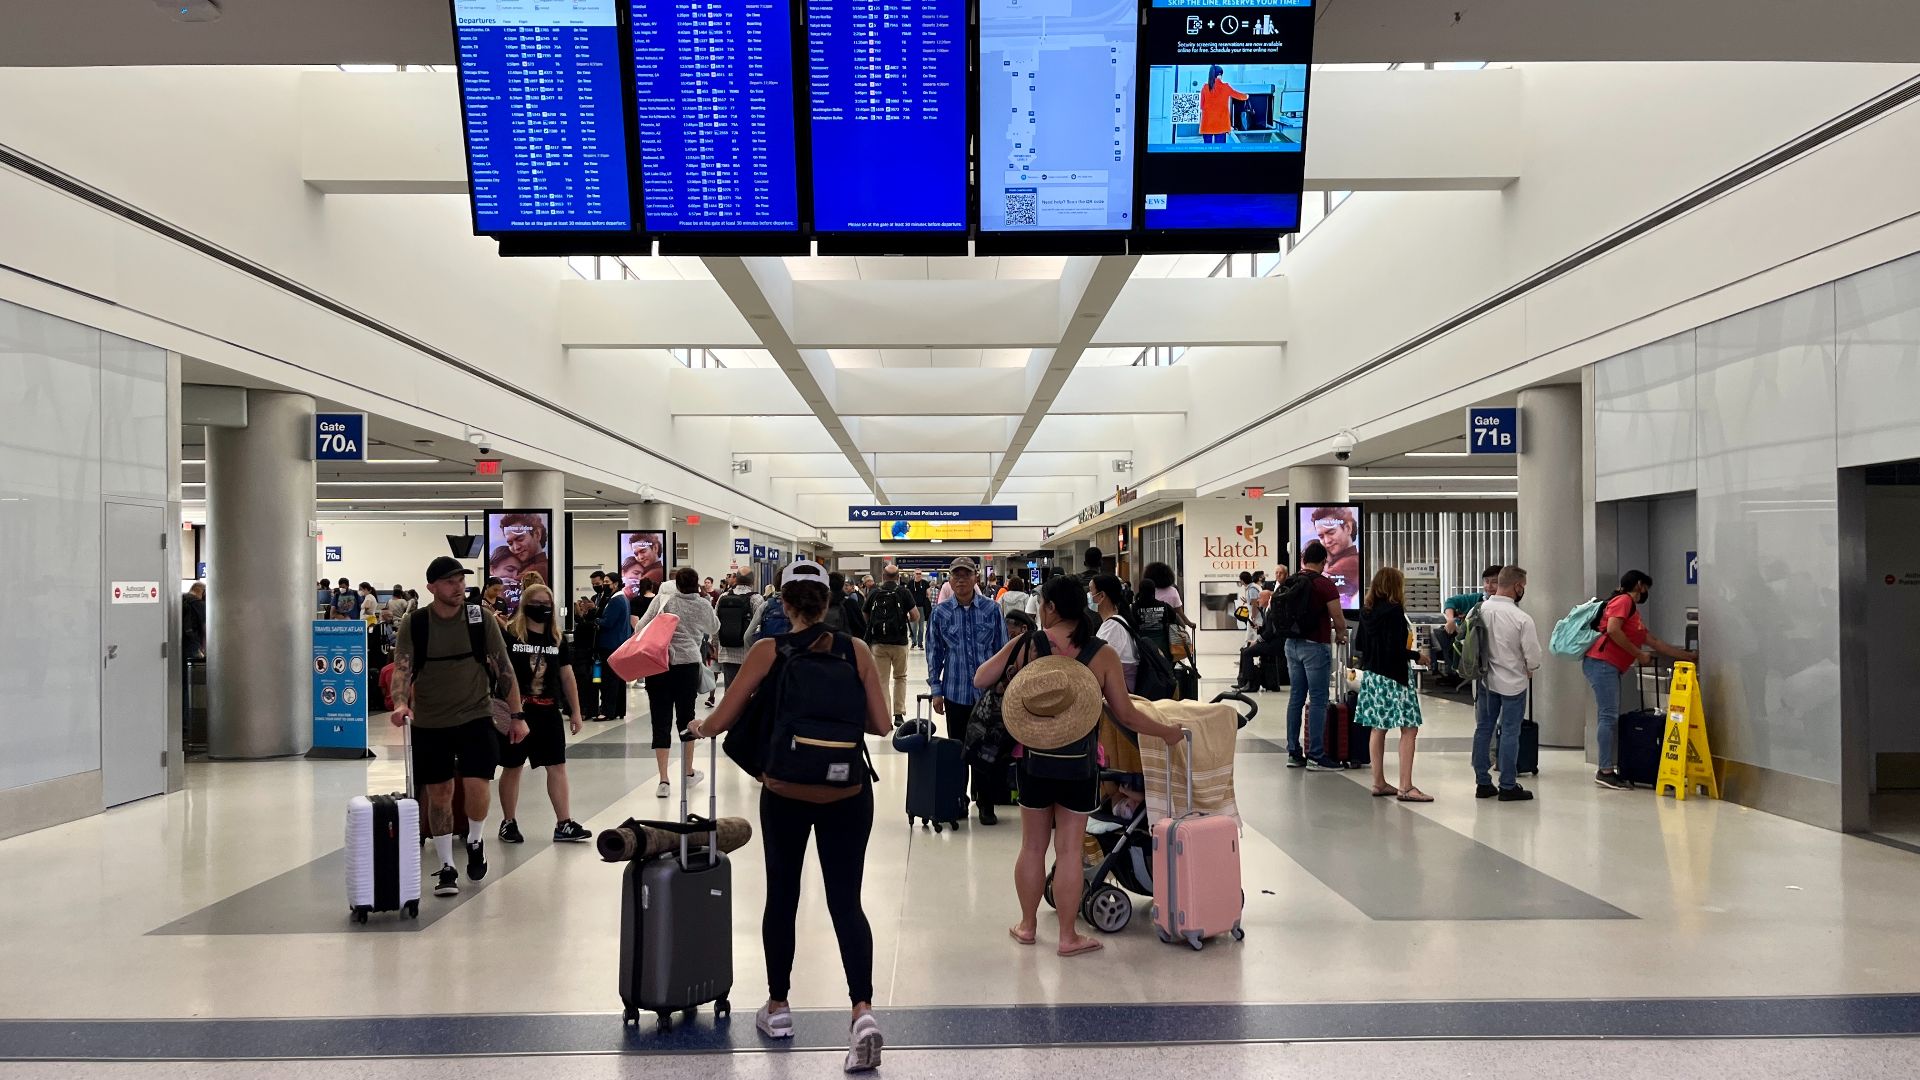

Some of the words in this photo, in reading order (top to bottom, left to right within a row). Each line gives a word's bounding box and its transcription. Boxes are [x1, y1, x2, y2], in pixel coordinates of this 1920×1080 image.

[1475, 416, 1499, 425] Gate
[320, 422, 345, 431] Gate
[1475, 428, 1511, 446] 71B
[320, 434, 356, 452] 70A
[888, 511, 902, 519] 72-77,
[939, 511, 958, 519] Lounge
[1204, 536, 1268, 557] klatch
[1212, 561, 1258, 570] COFFEE
[512, 644, 534, 653] SYSTEM
[546, 646, 559, 654] DOWN
